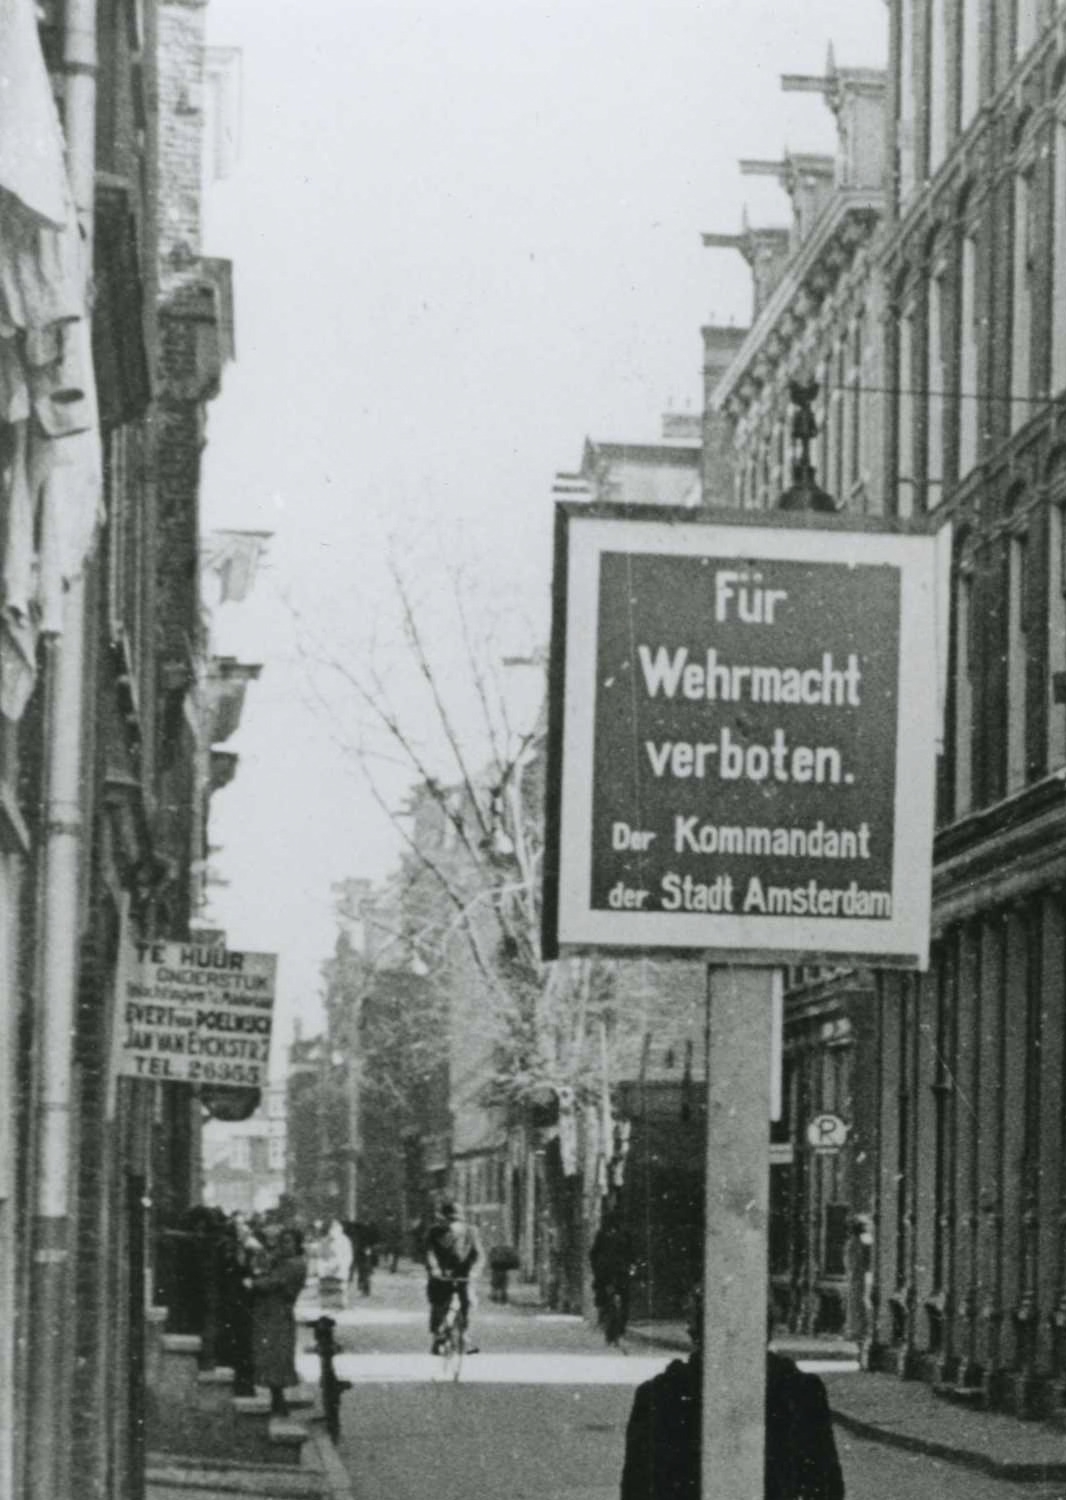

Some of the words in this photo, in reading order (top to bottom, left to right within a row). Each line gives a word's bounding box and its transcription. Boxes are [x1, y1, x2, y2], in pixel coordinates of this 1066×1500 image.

[715, 570, 788, 624] Für
[638, 645, 861, 706] Wehrmacht
[645, 726, 854, 784] verboten.
[612, 821, 656, 851] Der
[675, 815, 871, 859] Kommandant
[608, 882, 650, 909] der
[661, 871, 733, 912] Stadt
[743, 876, 891, 917] Amsterdam
[135, 942, 165, 964] TE
[181, 946, 244, 970] HUUR
